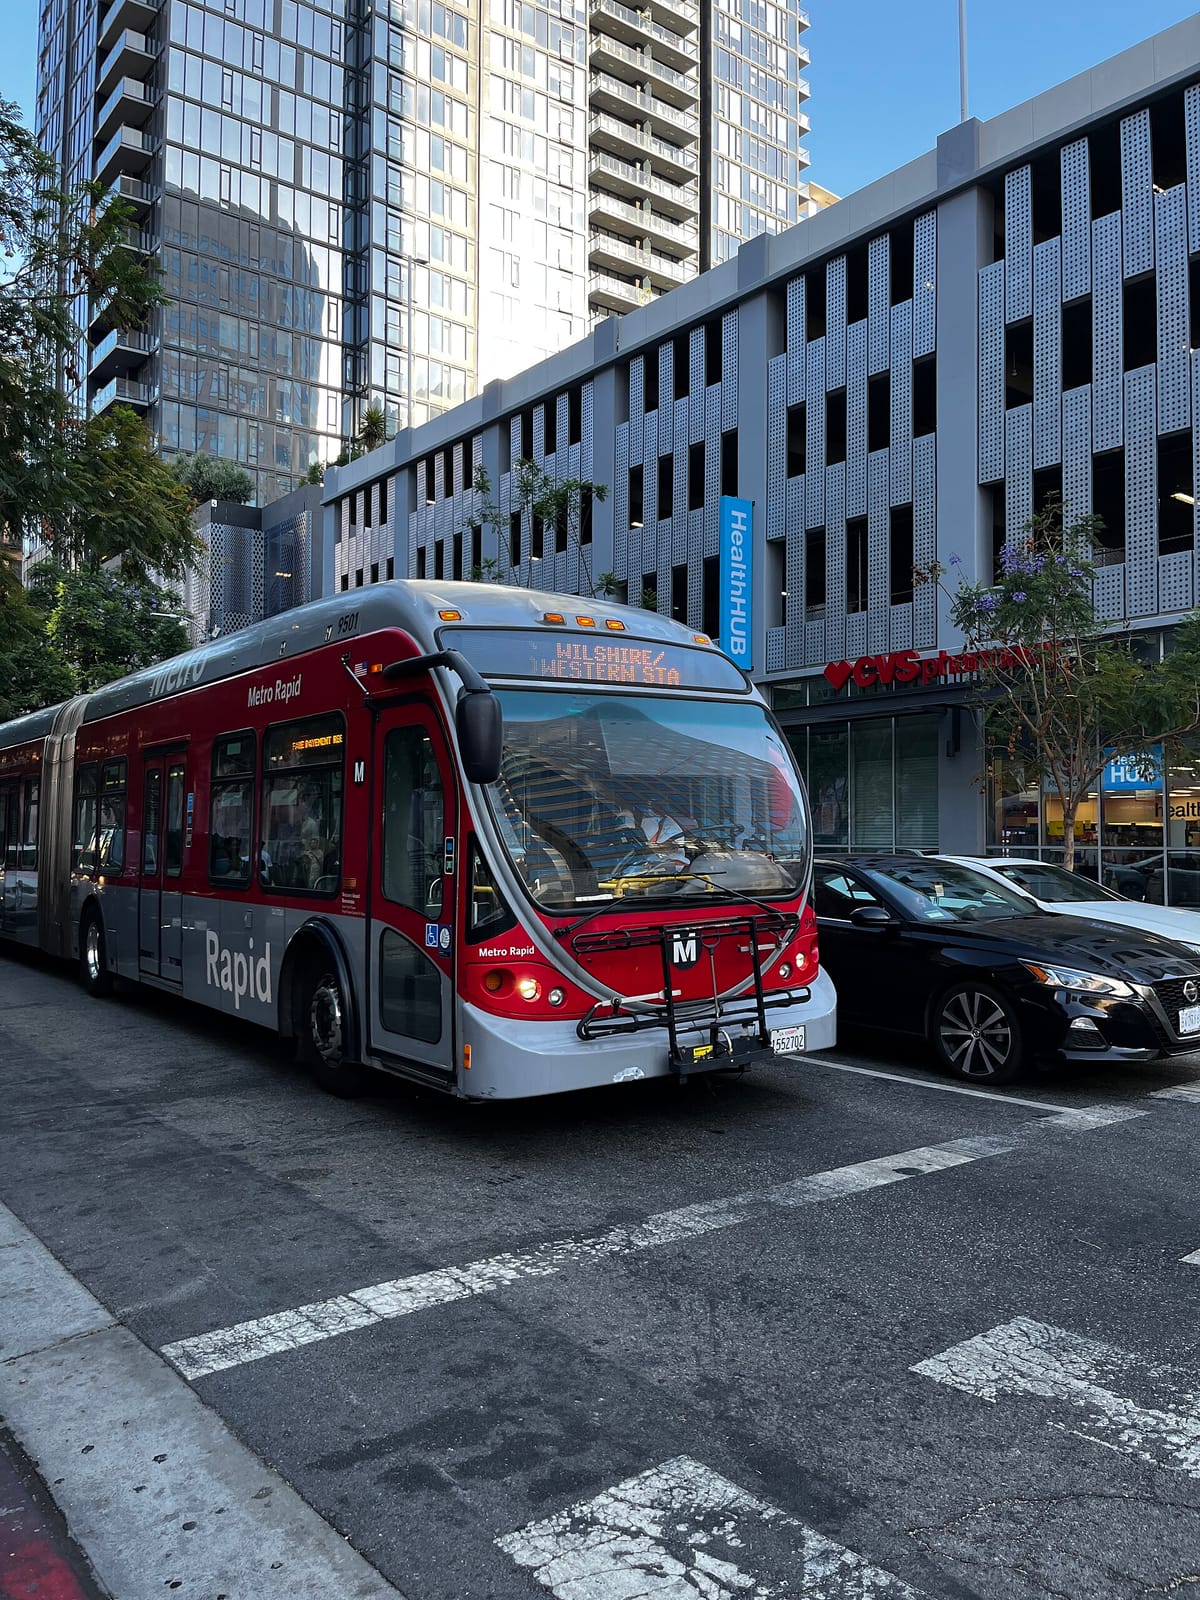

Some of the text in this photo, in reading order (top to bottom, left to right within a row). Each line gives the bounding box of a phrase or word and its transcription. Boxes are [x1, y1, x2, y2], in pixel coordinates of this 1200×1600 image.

[731, 510, 747, 655] HealthHUB
[338, 611, 359, 634] 9501
[556, 642, 665, 665] WILSHIRE/
[541, 658, 680, 685] WESTERN STA
[853, 650, 920, 688] CVS
[247, 674, 302, 708] Metro Rapid
[354, 761, 364, 782] M
[1111, 765, 1155, 783] HU
[1155, 801, 1200, 818] healt
[479, 946, 535, 958] Metro Rapid
[673, 932, 696, 963] M
[206, 929, 272, 1010] Rapid
